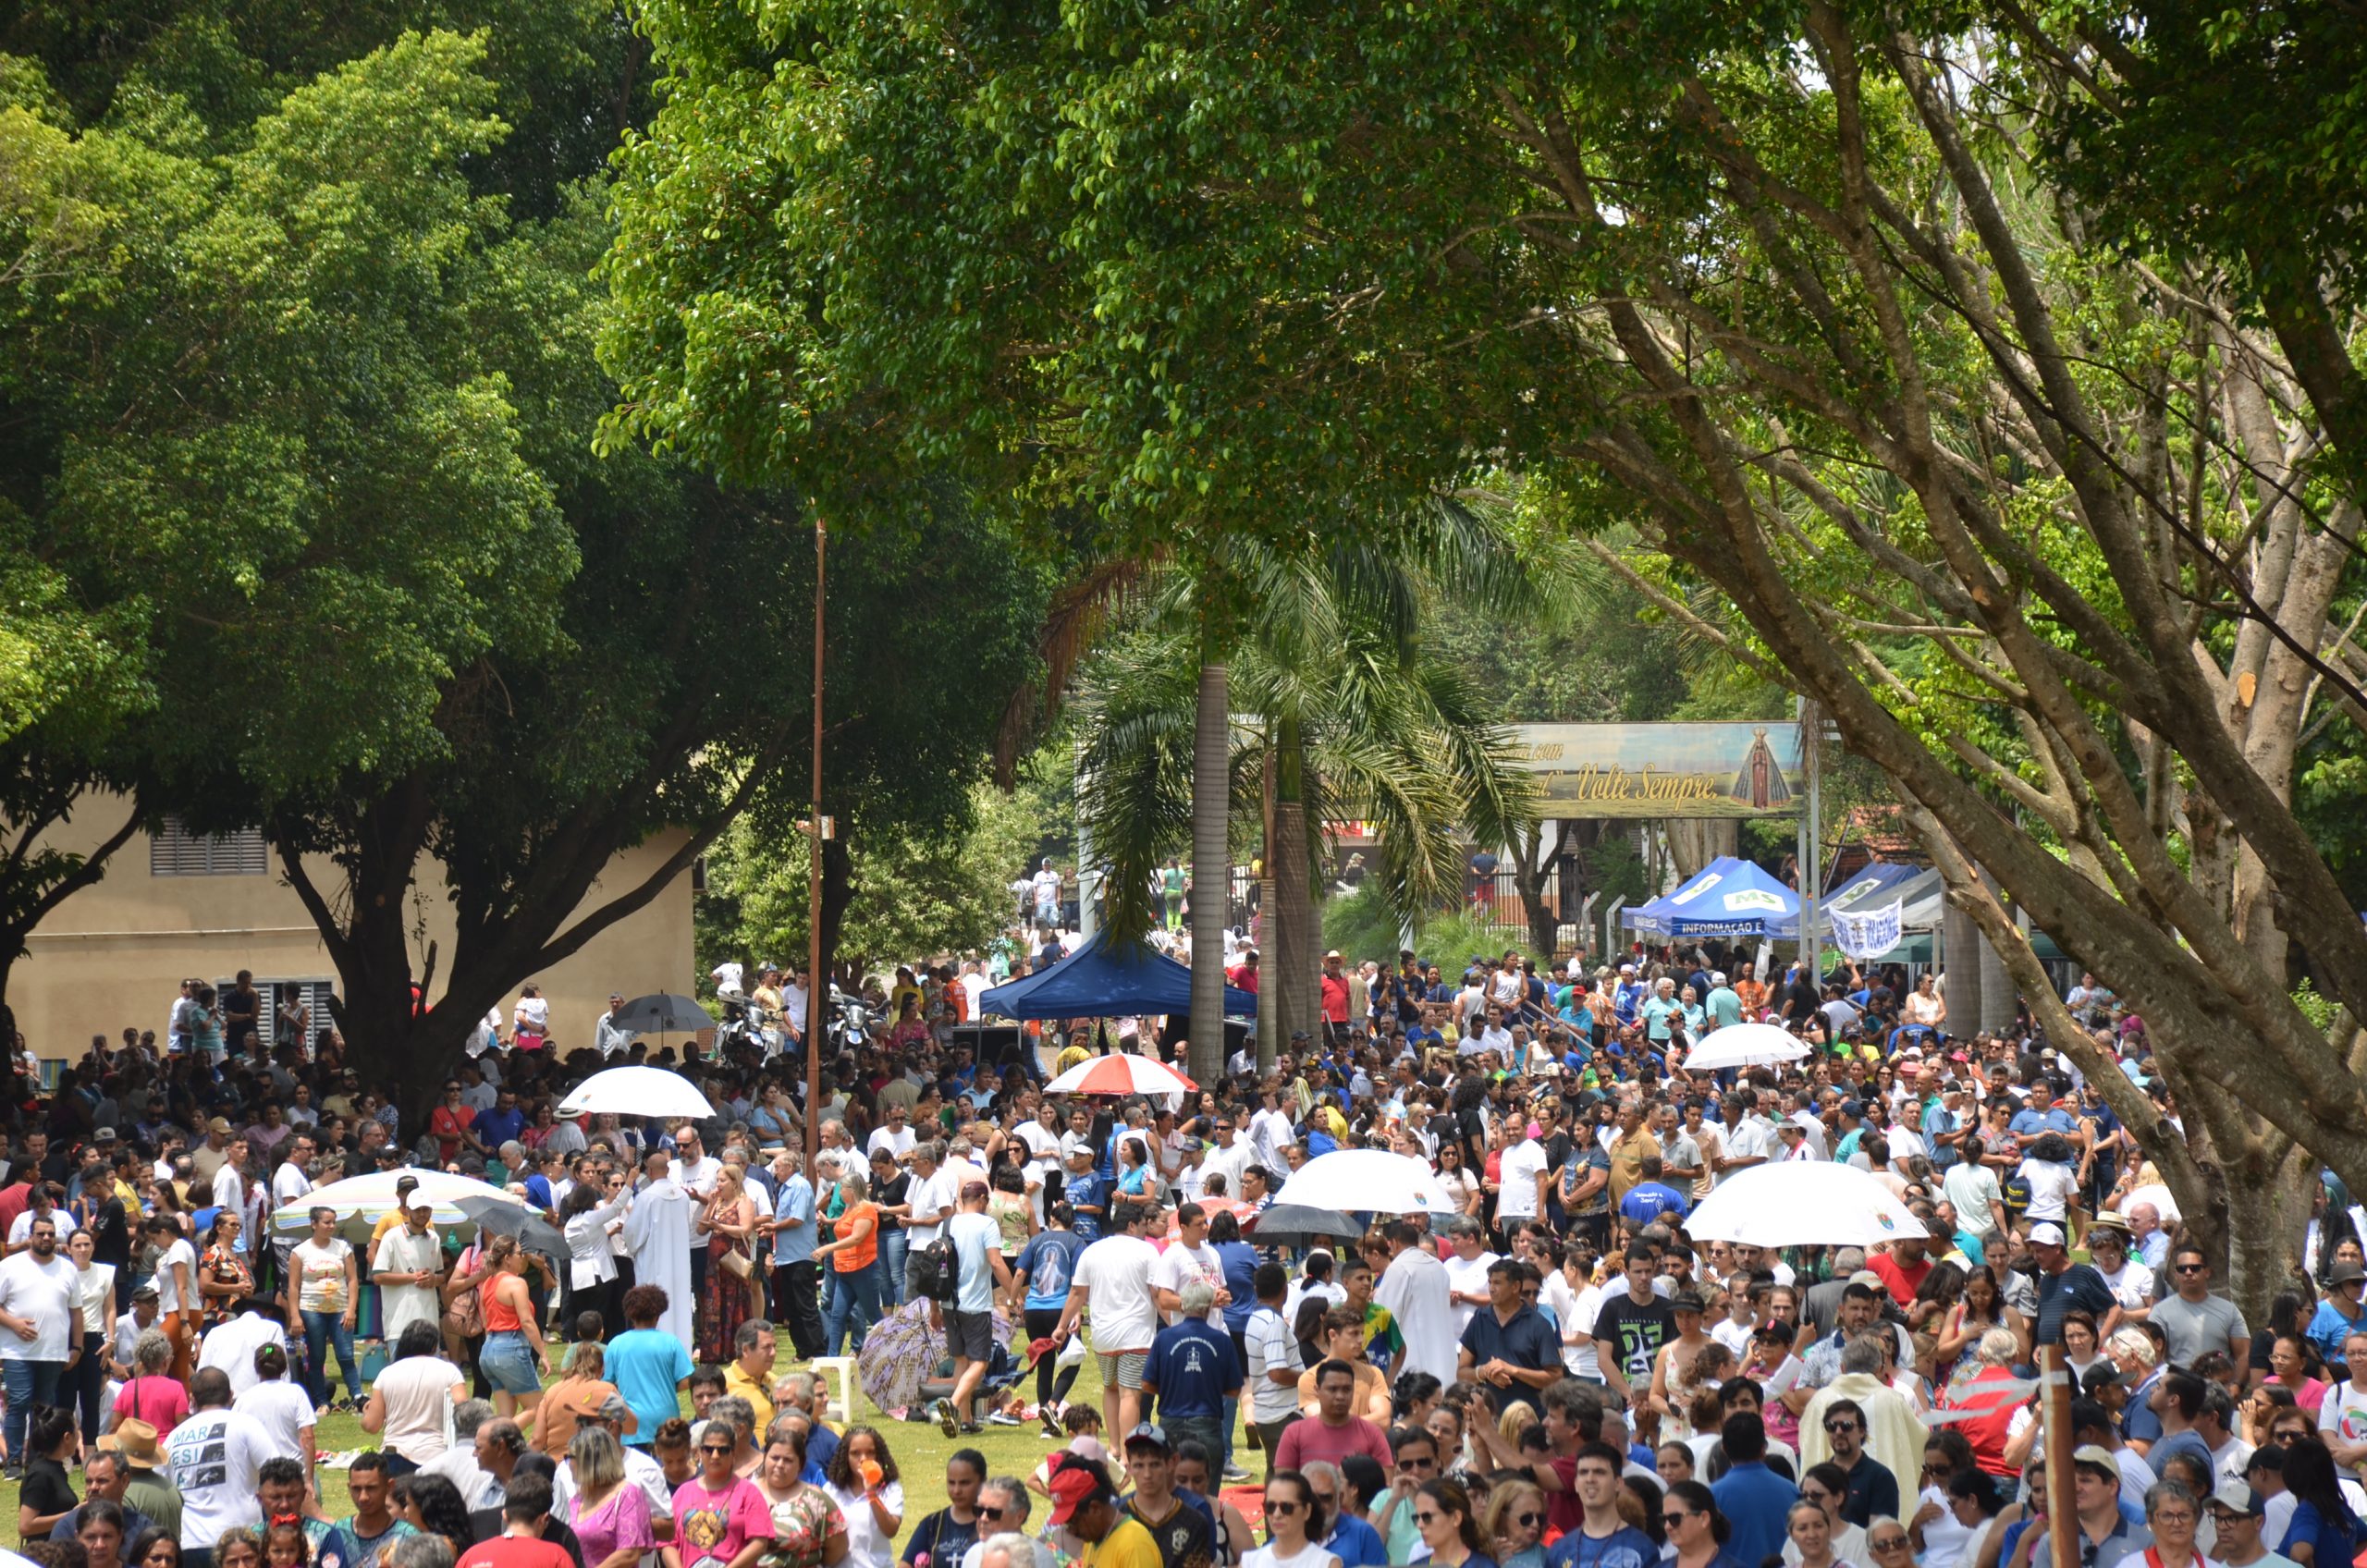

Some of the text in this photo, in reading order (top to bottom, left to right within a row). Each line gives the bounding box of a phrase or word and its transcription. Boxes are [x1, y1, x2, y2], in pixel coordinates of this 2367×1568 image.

[1577, 763, 1631, 800] Volte
[1635, 763, 1717, 812] Sempre.
[1735, 893, 1776, 904] MS
[174, 1427, 207, 1443] MAR
